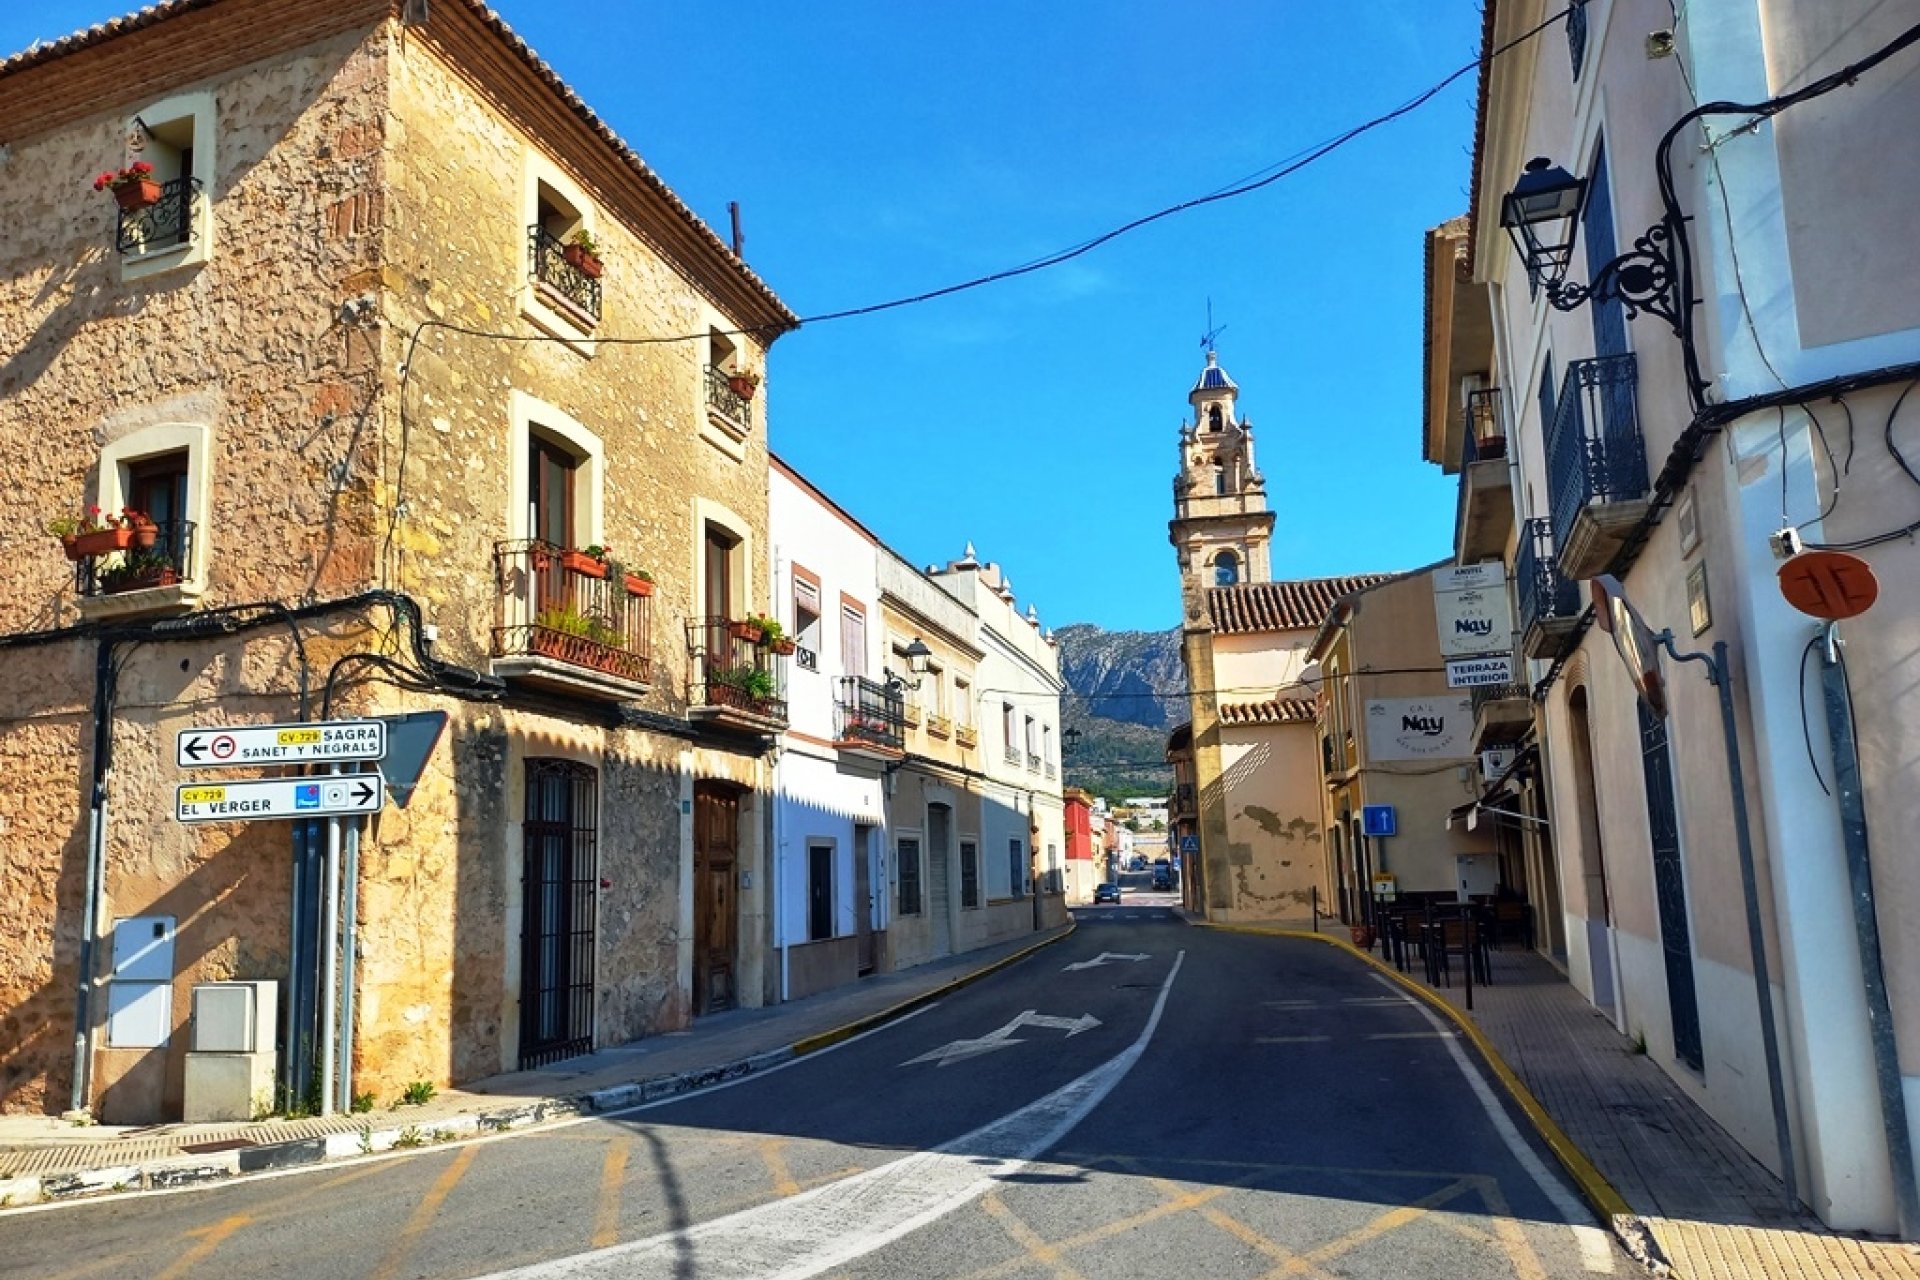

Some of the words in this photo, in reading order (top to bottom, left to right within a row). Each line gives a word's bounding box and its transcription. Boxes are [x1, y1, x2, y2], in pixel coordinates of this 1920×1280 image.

[1455, 618, 1492, 636] Nay
[1453, 661, 1508, 674] TERRAZA
[1453, 672, 1509, 686] INTERIOR
[1402, 714, 1445, 736] Nay
[323, 727, 377, 742] SAGRA
[242, 746, 288, 759] SANET
[297, 745, 305, 756] Y
[313, 742, 378, 755] NEGRALS
[181, 804, 199, 816] EL
[210, 799, 271, 814] VERGER
